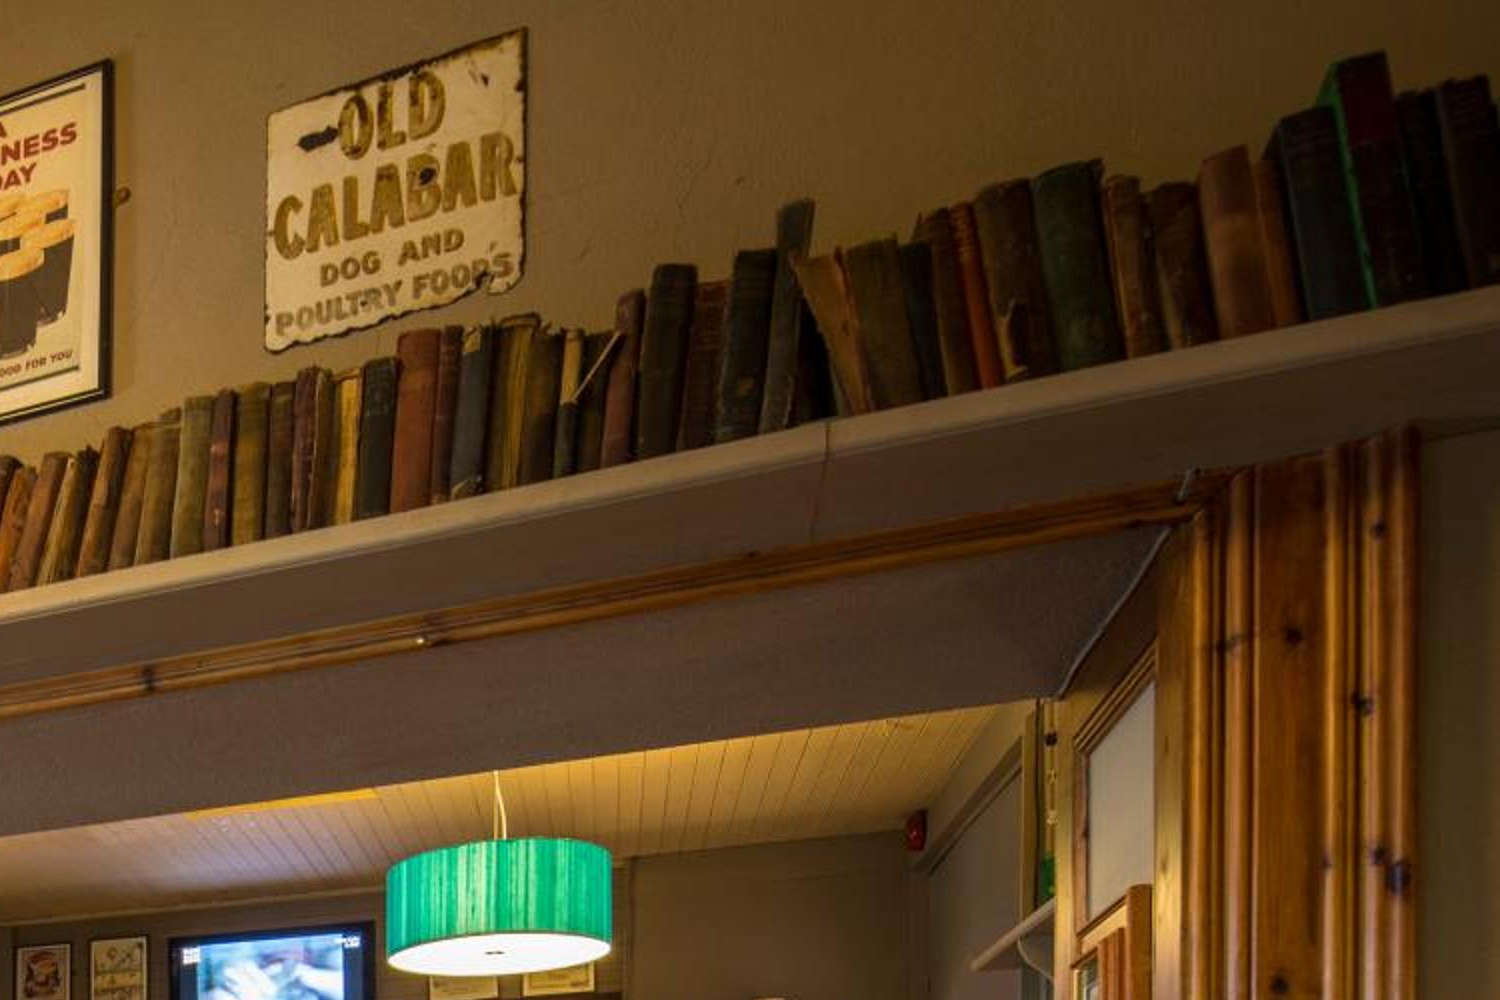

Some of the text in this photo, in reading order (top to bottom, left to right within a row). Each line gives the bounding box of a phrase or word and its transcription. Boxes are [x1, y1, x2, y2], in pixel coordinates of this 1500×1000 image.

[338, 70, 446, 160] OLD
[274, 131, 518, 261] CALABAR
[320, 228, 464, 287] DOG AND
[275, 280, 404, 336] POULTRY
[25, 356, 47, 372] FOR
[49, 350, 73, 364] YOU
